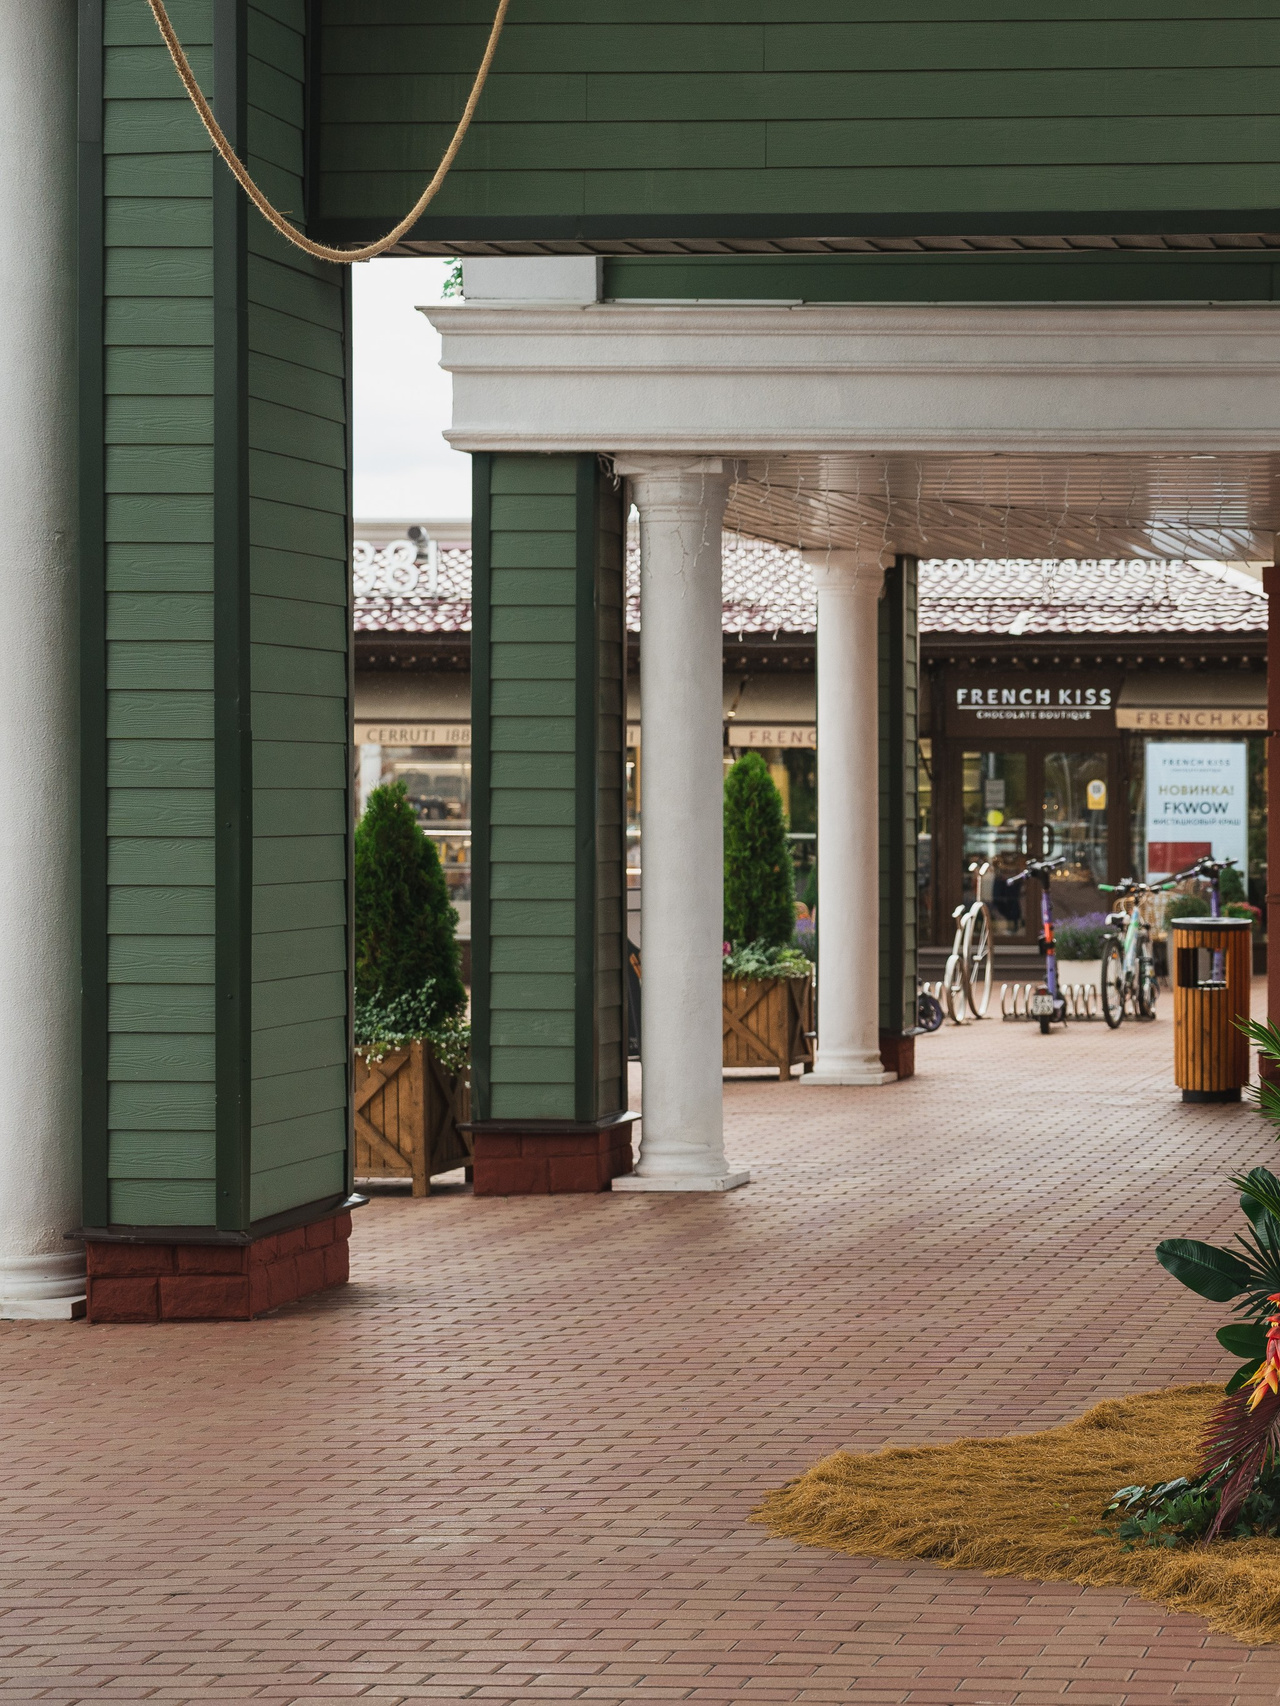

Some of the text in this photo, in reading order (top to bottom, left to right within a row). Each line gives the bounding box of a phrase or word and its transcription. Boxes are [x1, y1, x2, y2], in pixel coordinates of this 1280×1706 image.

[1042, 558, 1184, 579] BOUTIQUE
[956, 688, 1112, 705] FRENCH KISS
[976, 710, 1092, 721] CHOCOLATE BOUTIQUE
[1136, 712, 1266, 726] FRENCH KIS
[366, 728, 470, 743] CERRUTI 188
[748, 729, 817, 744] FRENC
[1158, 785, 1235, 796] НОВИНКА!
[1163, 801, 1230, 815] FKWOW
